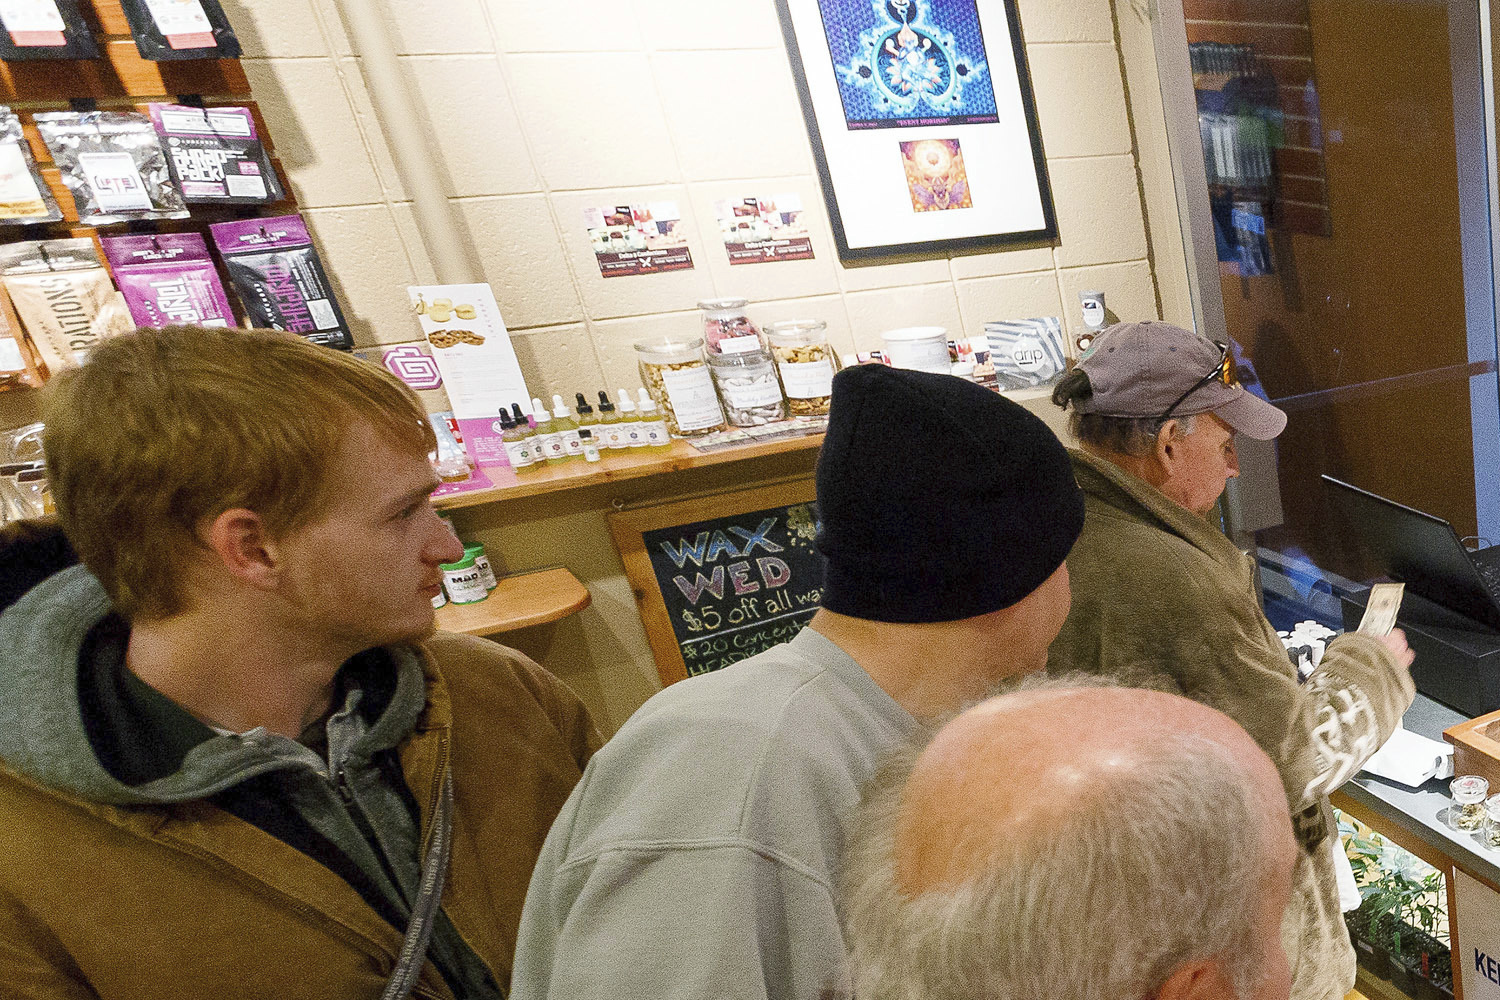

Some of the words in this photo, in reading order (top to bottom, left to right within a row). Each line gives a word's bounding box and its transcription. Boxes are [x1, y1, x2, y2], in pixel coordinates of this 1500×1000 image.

[660, 517, 784, 568] WAX
[673, 556, 791, 605] WED
[682, 606, 722, 632] $5
[727, 597, 761, 624] off
[765, 589, 793, 613] all
[796, 587, 825, 605] wa
[684, 638, 728, 659] $20
